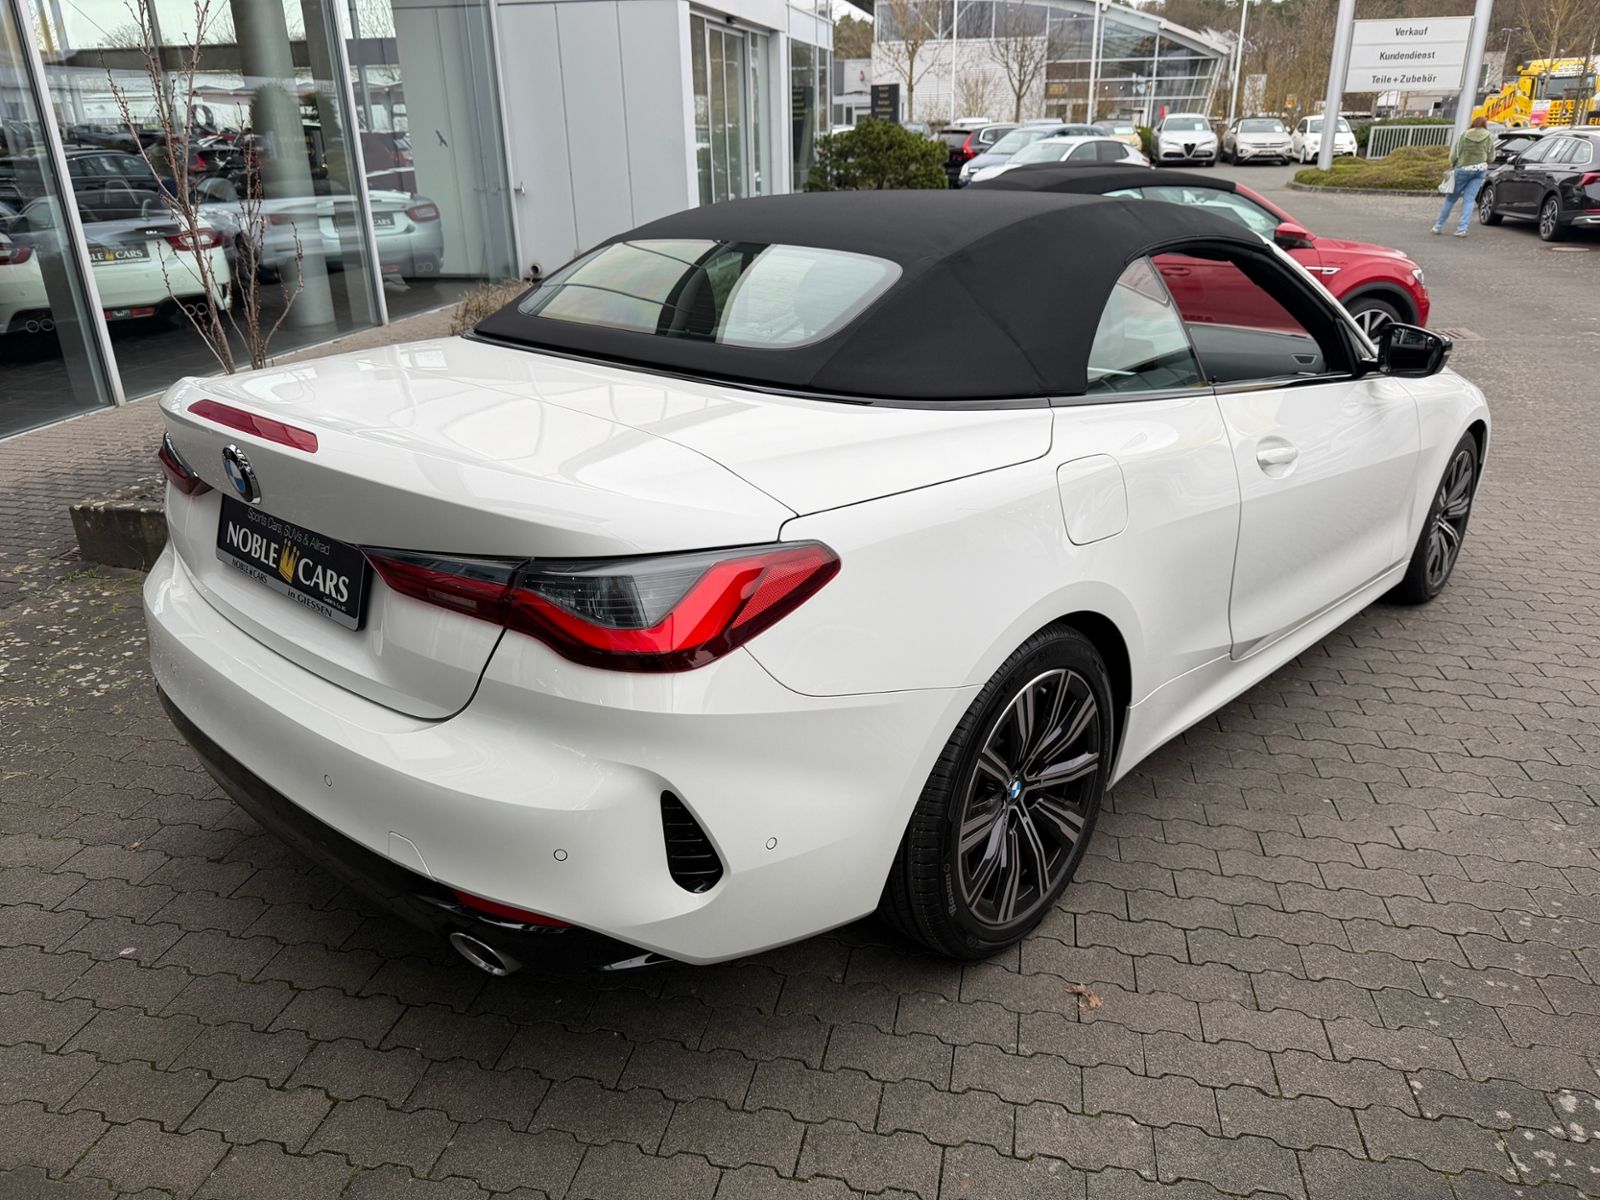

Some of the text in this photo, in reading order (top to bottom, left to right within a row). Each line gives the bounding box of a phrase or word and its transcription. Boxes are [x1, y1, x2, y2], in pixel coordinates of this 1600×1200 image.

[1395, 26, 1428, 36] Verkauf
[1379, 51, 1435, 61] Kundendienst
[115, 249, 143, 259] CARS
[247, 507, 266, 526] Sports
[310, 537, 331, 555] Allrad
[226, 520, 349, 603] NOBLE CARS
[232, 558, 268, 584] NOBLE CARS
[288, 587, 296, 599] in
[297, 592, 333, 618] GIESSEN
